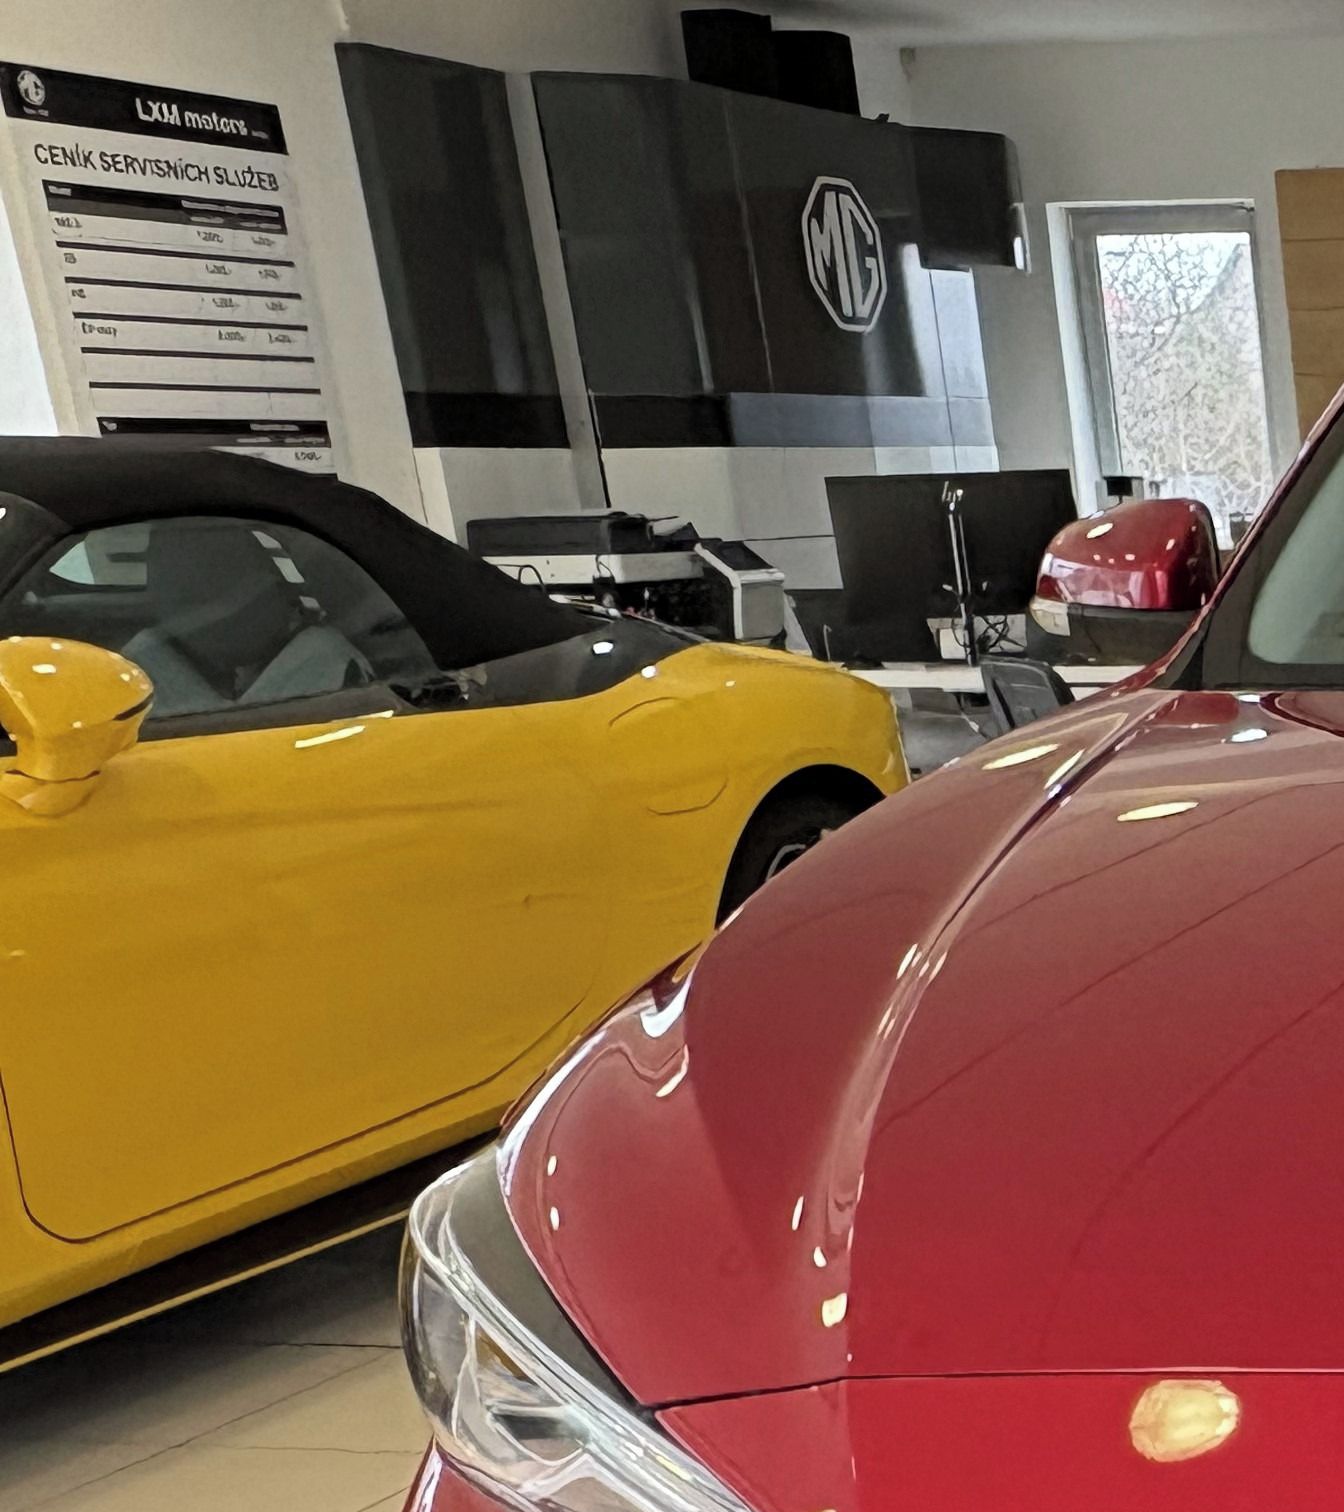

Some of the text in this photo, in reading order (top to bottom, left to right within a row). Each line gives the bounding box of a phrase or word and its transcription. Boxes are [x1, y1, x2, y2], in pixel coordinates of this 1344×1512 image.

[135, 97, 248, 136] LXM motors
[34, 143, 97, 169] CENÍK
[810, 190, 880, 318] MG
